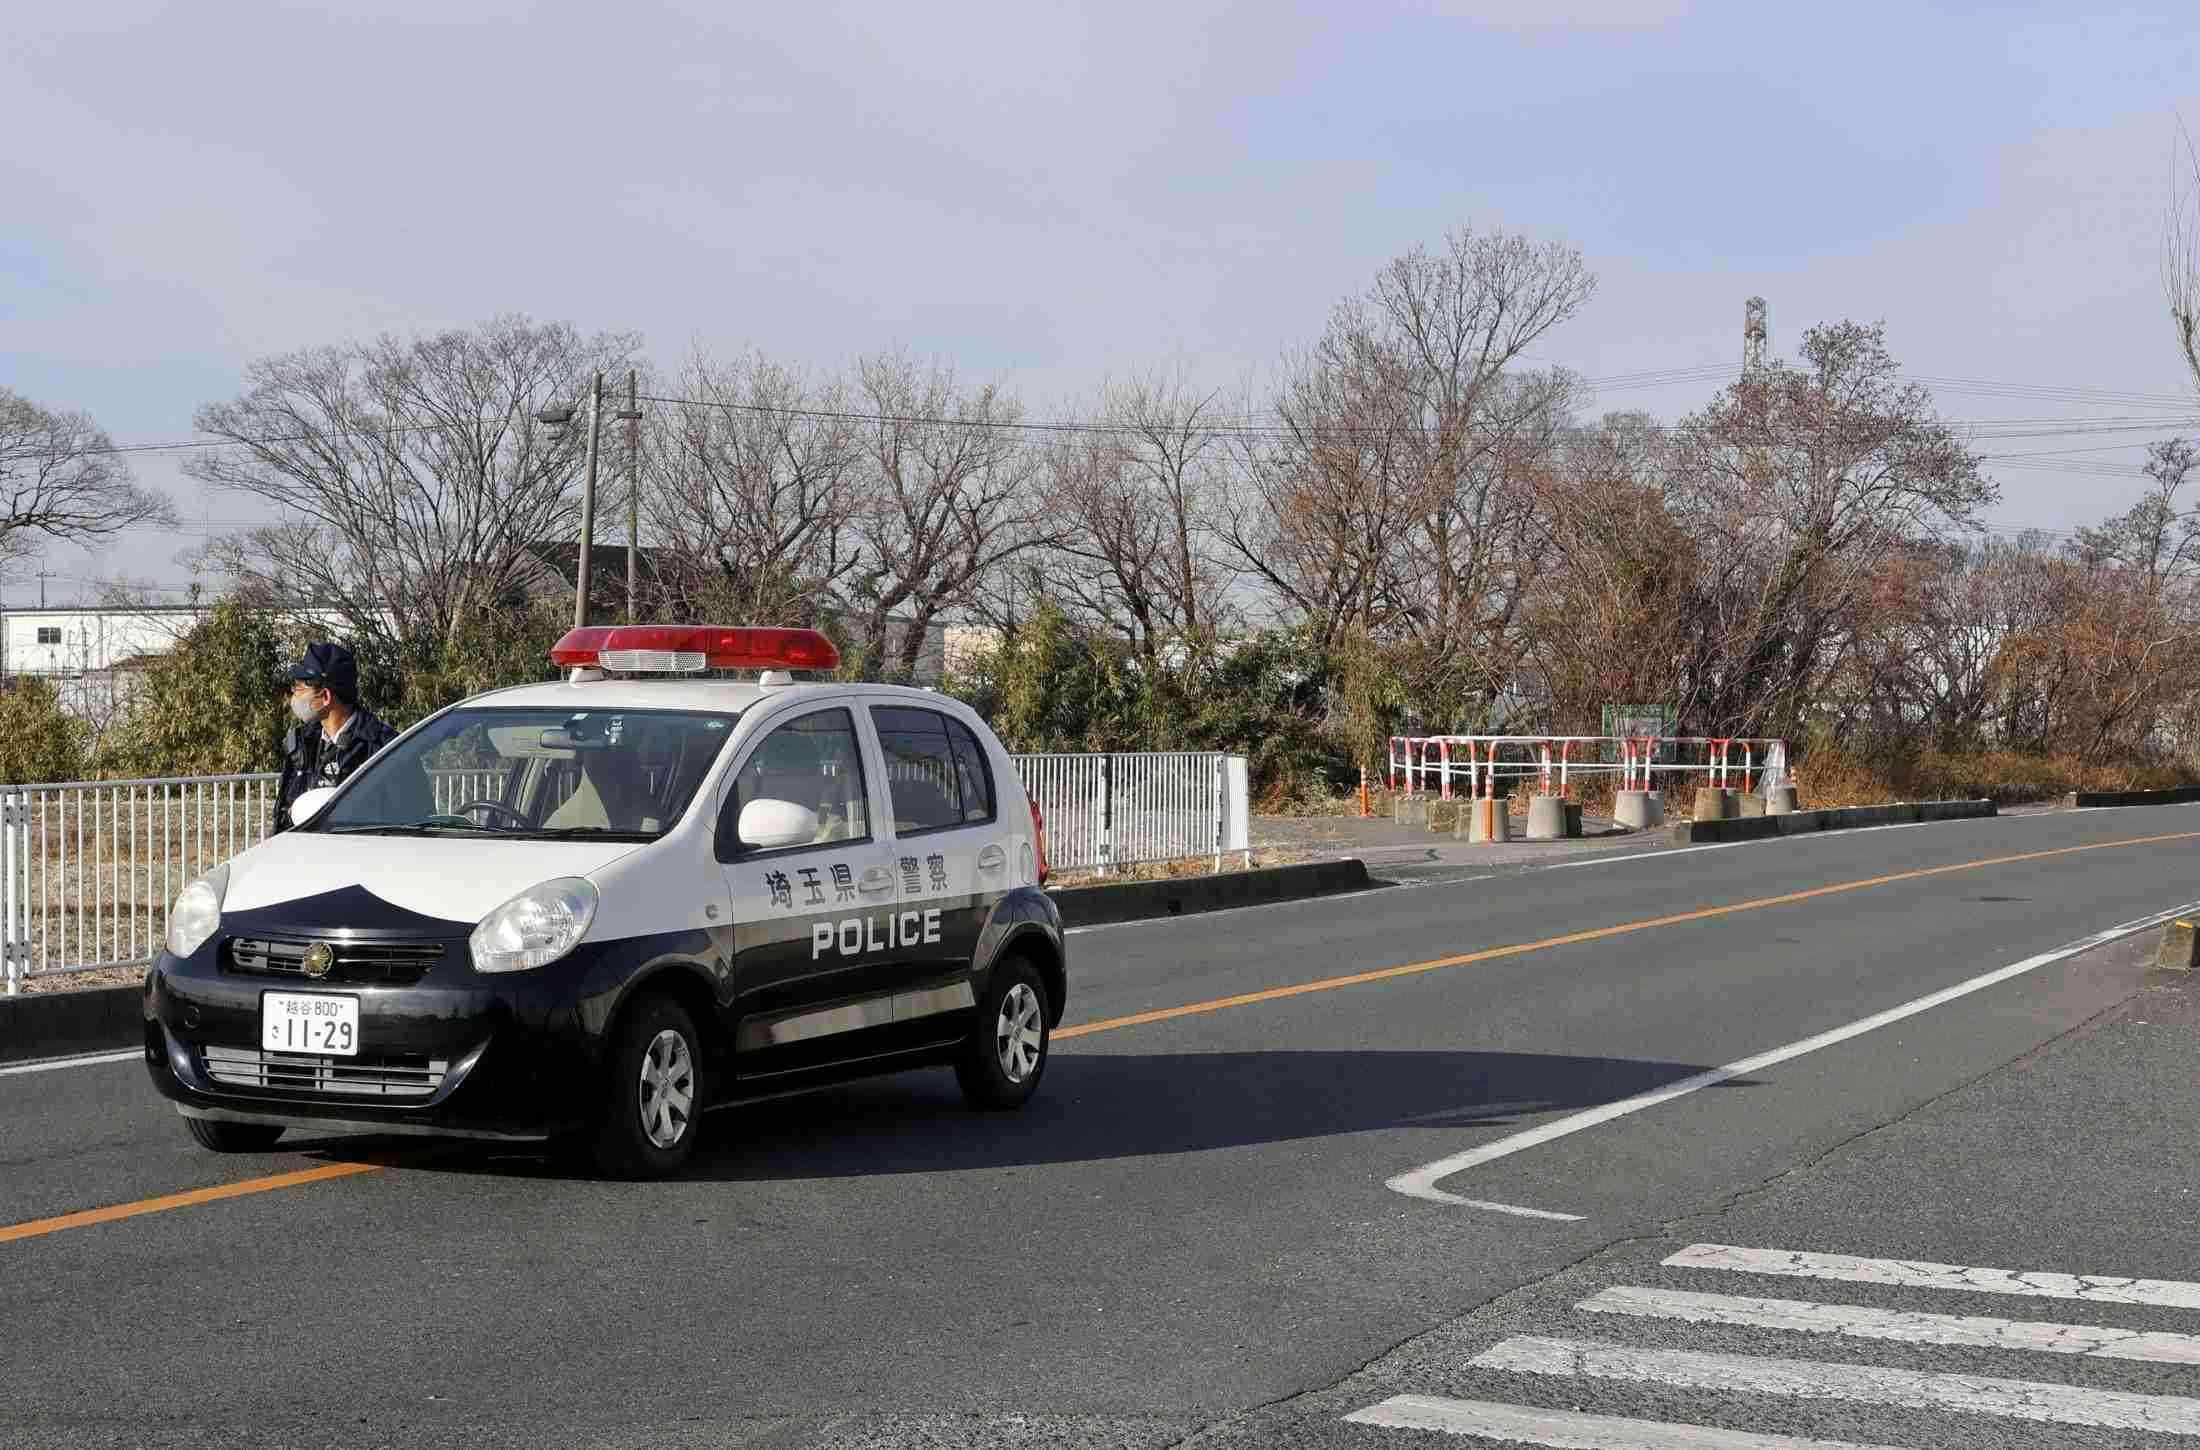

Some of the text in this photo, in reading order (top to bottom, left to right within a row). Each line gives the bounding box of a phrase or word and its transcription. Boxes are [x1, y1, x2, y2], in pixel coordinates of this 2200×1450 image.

[765, 852, 949, 909] 埼玉県 警察
[811, 907, 943, 960] POLICE
[287, 1018, 353, 1050] 11-29
